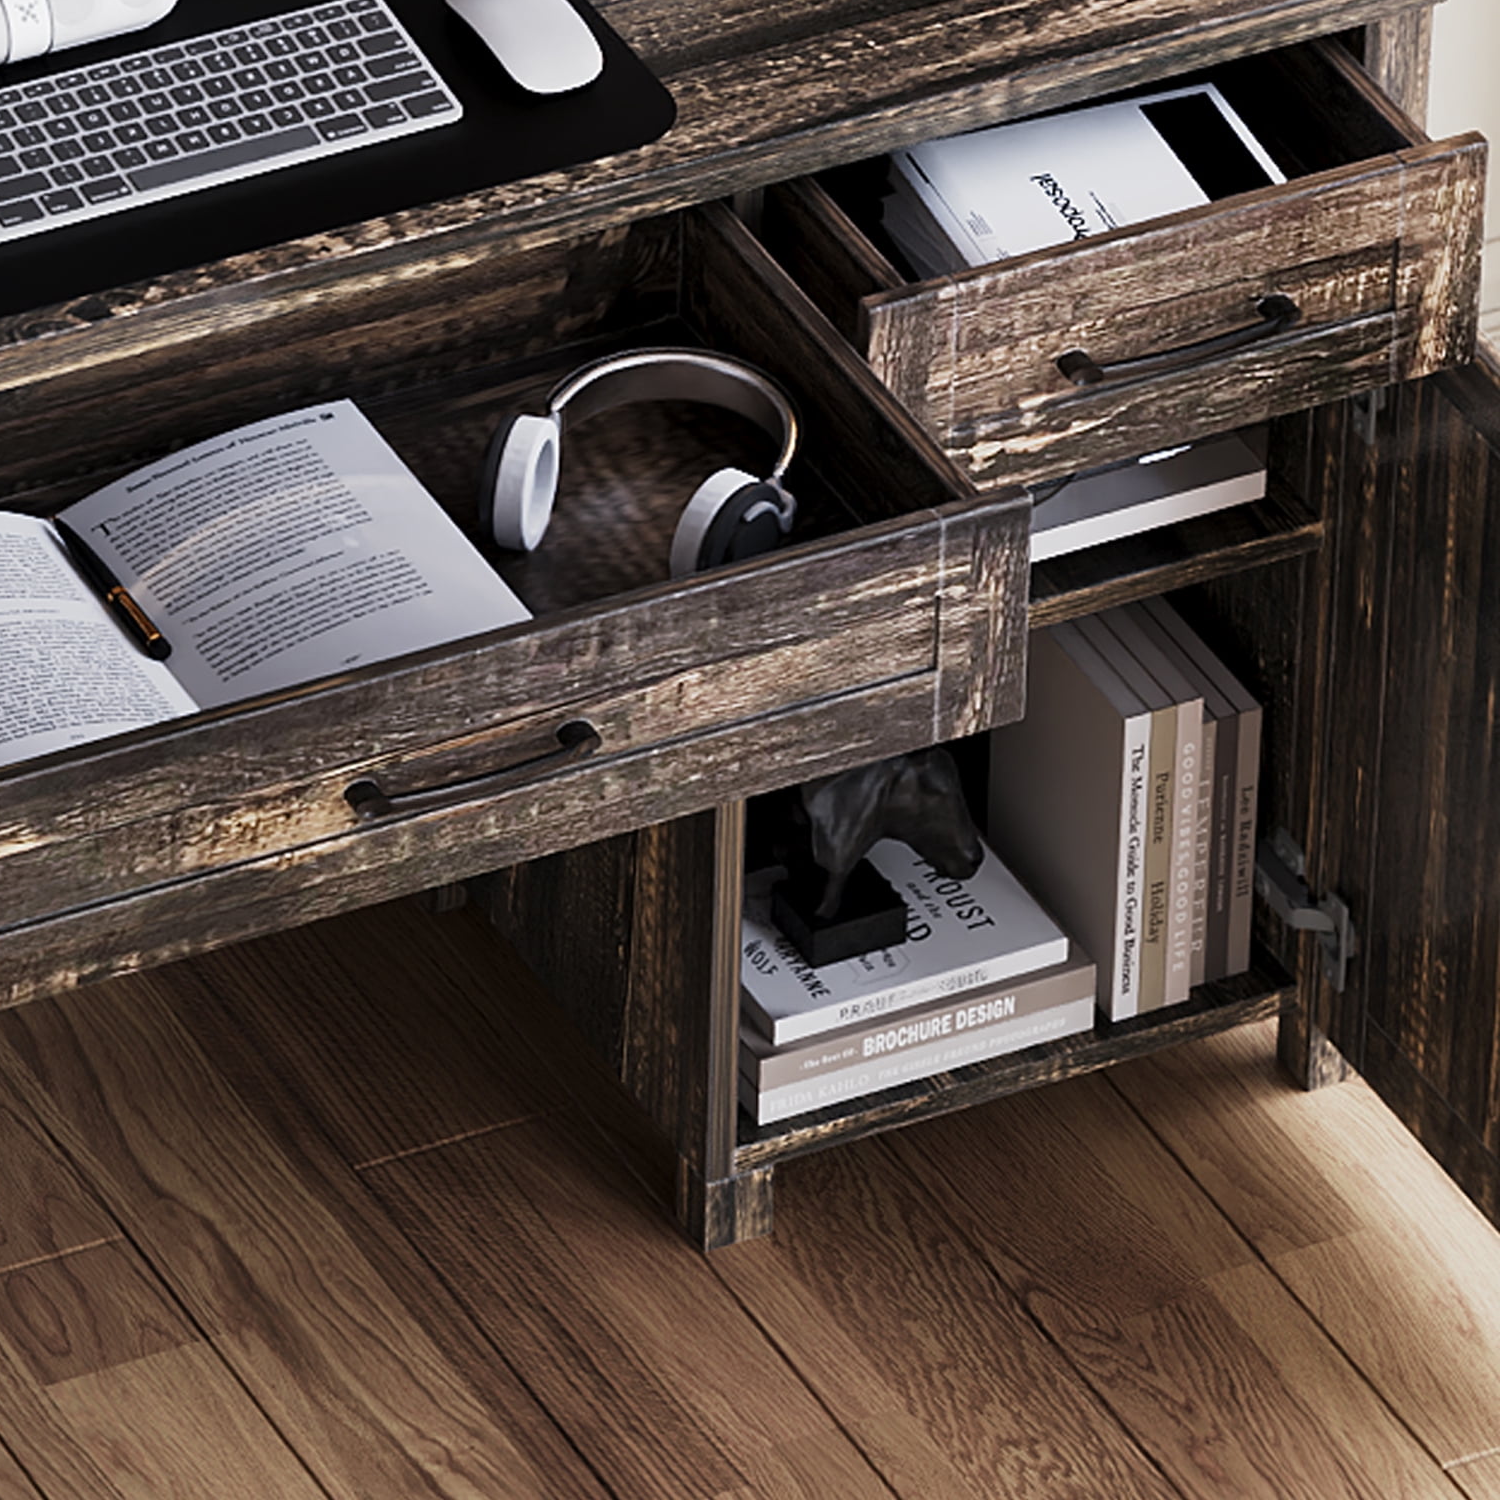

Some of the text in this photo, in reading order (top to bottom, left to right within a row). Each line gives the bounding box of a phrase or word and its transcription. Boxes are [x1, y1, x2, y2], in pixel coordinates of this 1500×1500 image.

[1181, 742, 1196, 799] GOOD
[862, 1012, 953, 1058] BROCHURE
[955, 995, 1016, 1032] DESIGN
